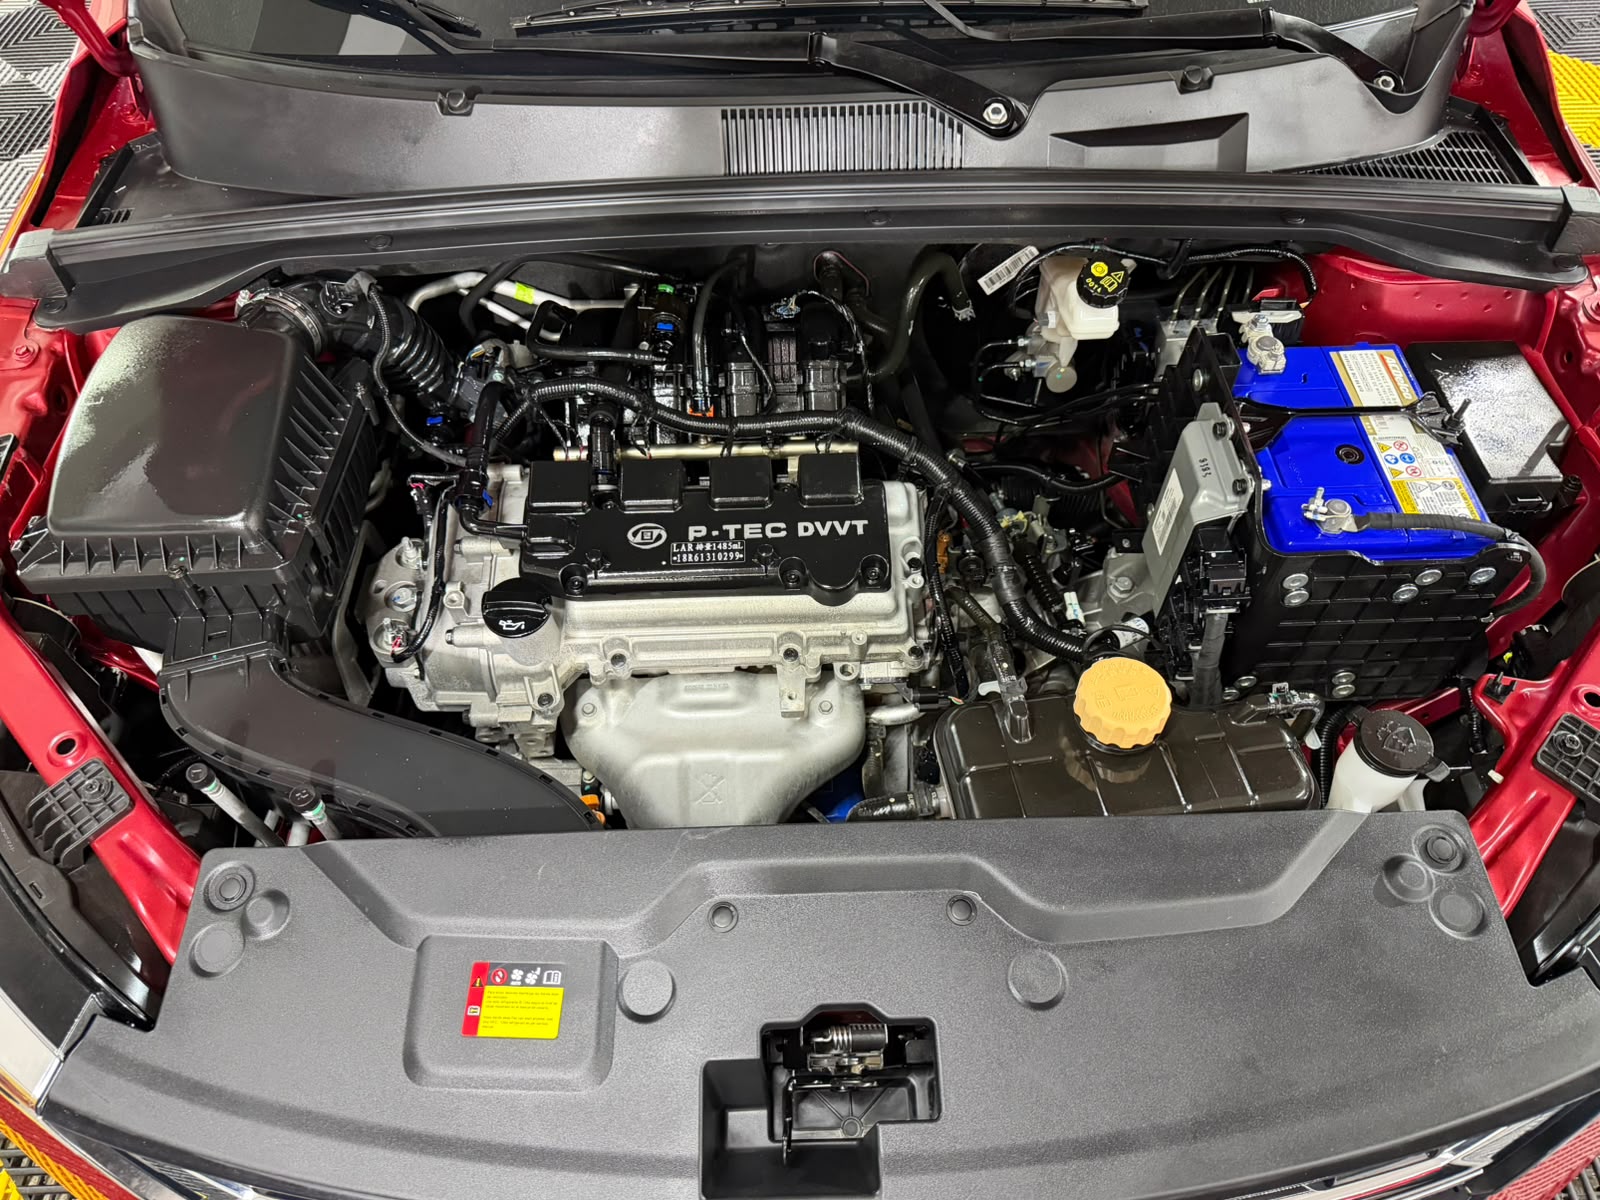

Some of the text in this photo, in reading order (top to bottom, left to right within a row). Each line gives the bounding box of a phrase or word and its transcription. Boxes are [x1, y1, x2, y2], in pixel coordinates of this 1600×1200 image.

[1384, 355, 1413, 400] ACDelco
[797, 520, 868, 537] DVVT
[673, 543, 694, 552] LAR
